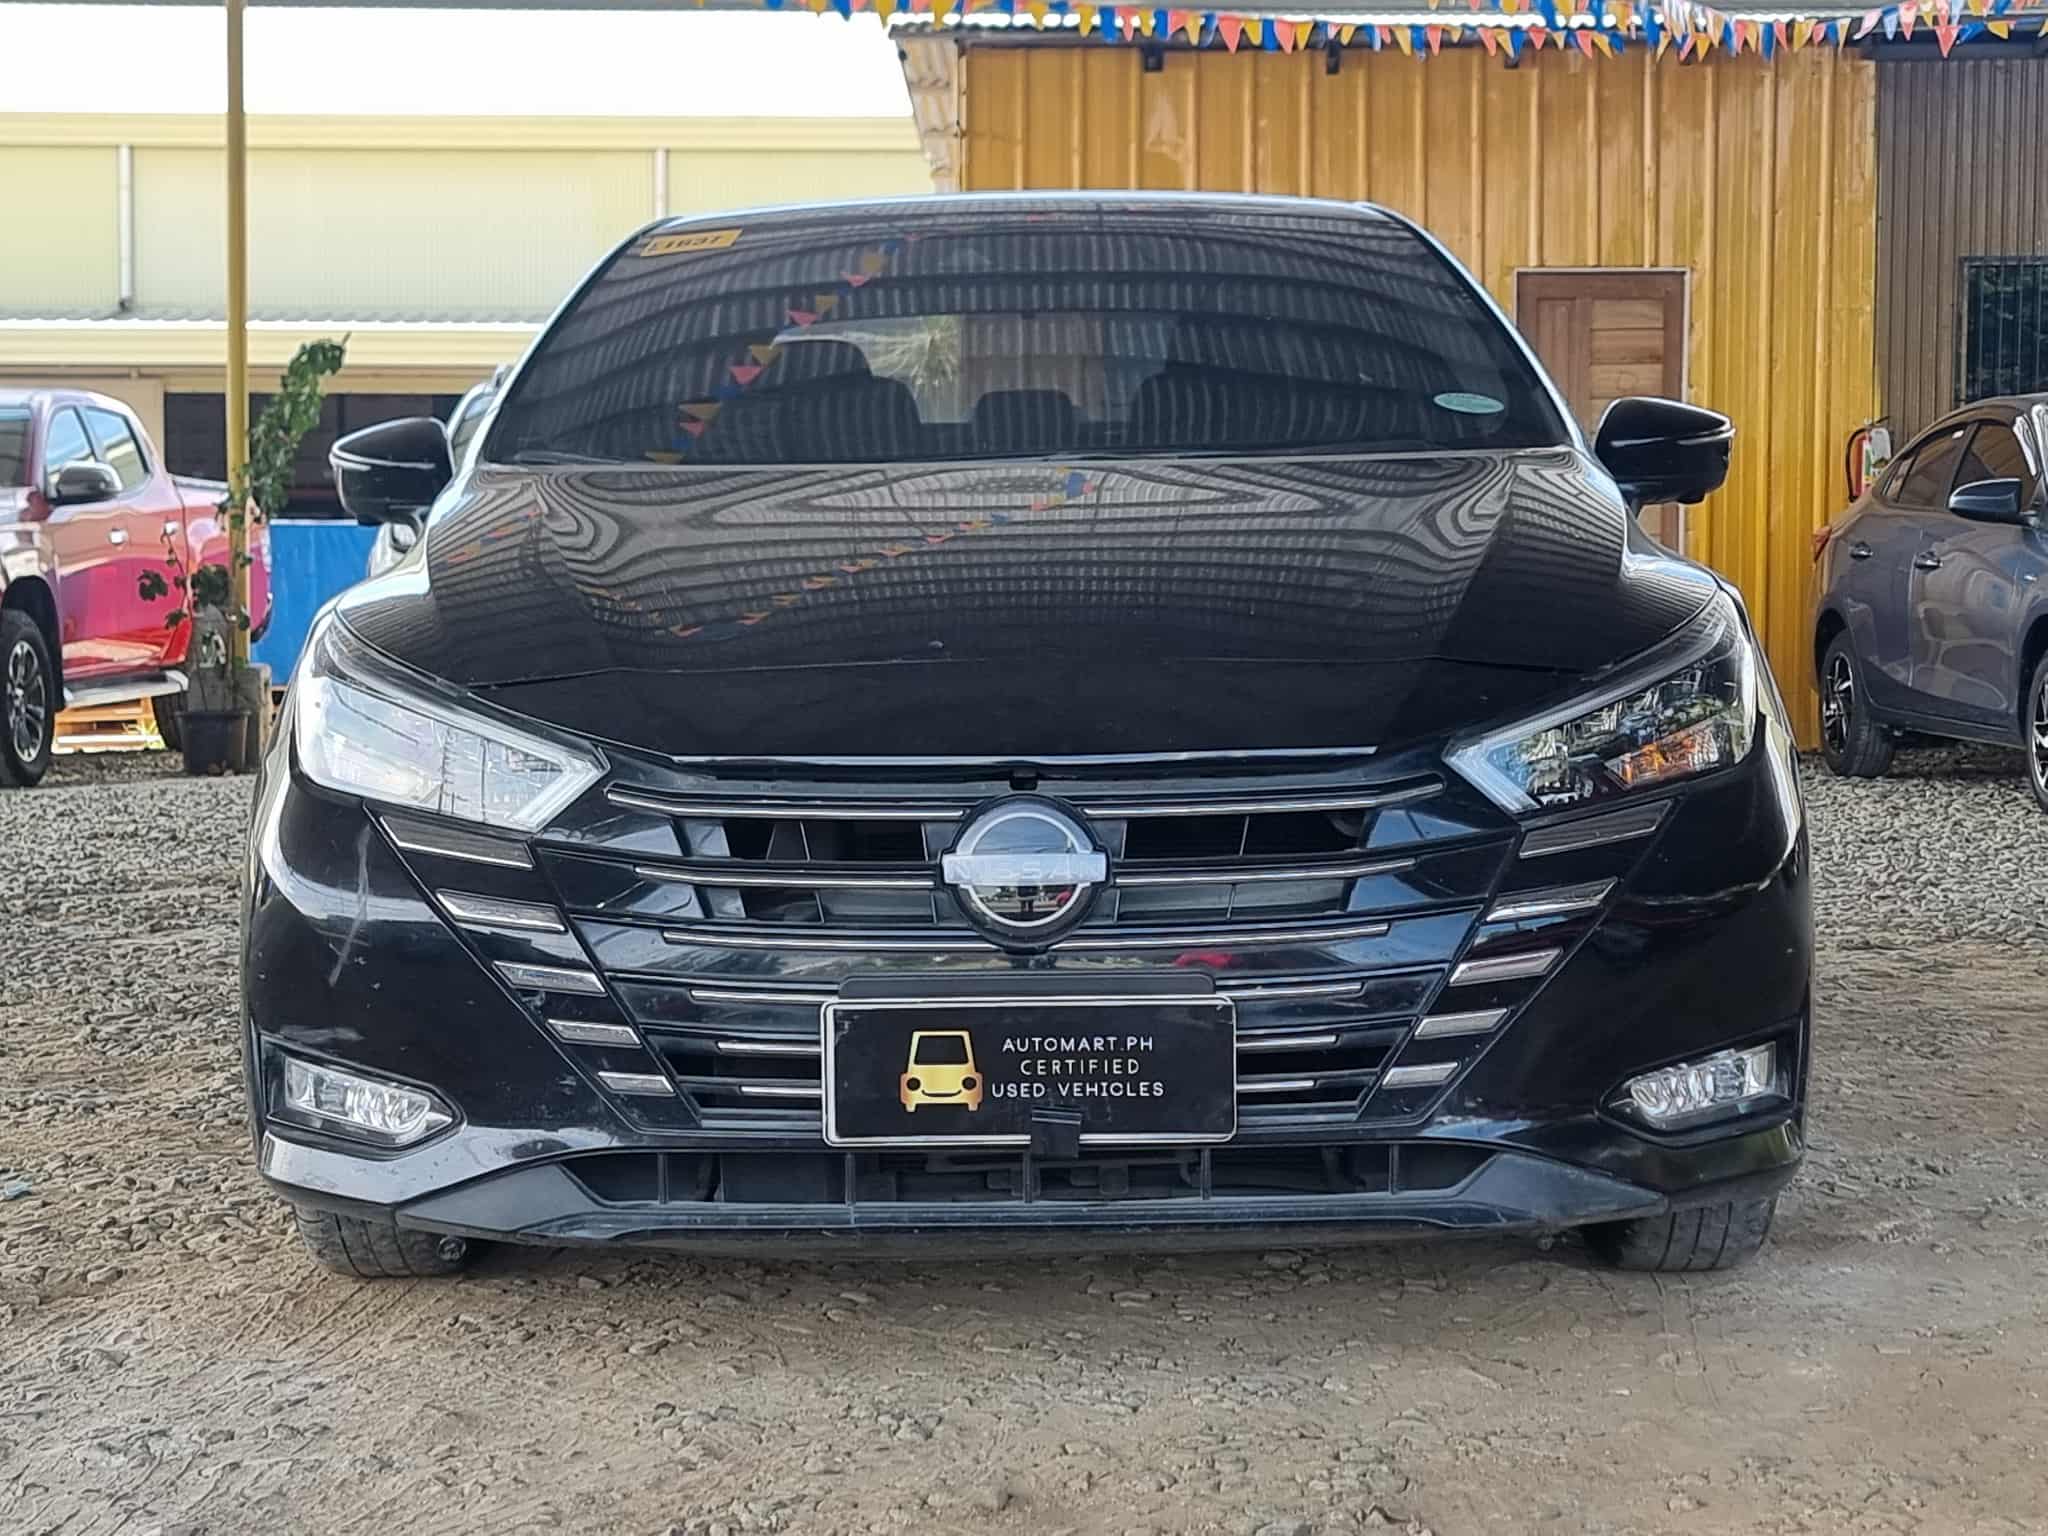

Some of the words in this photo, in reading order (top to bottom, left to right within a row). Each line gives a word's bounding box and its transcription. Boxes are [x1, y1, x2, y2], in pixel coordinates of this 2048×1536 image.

[1002, 1036, 1154, 1052] AUTOMART.PH
[1020, 1058, 1140, 1076] CERTIFIED
[991, 1082, 1047, 1098] USED
[1057, 1081, 1164, 1098] VEHICLES
